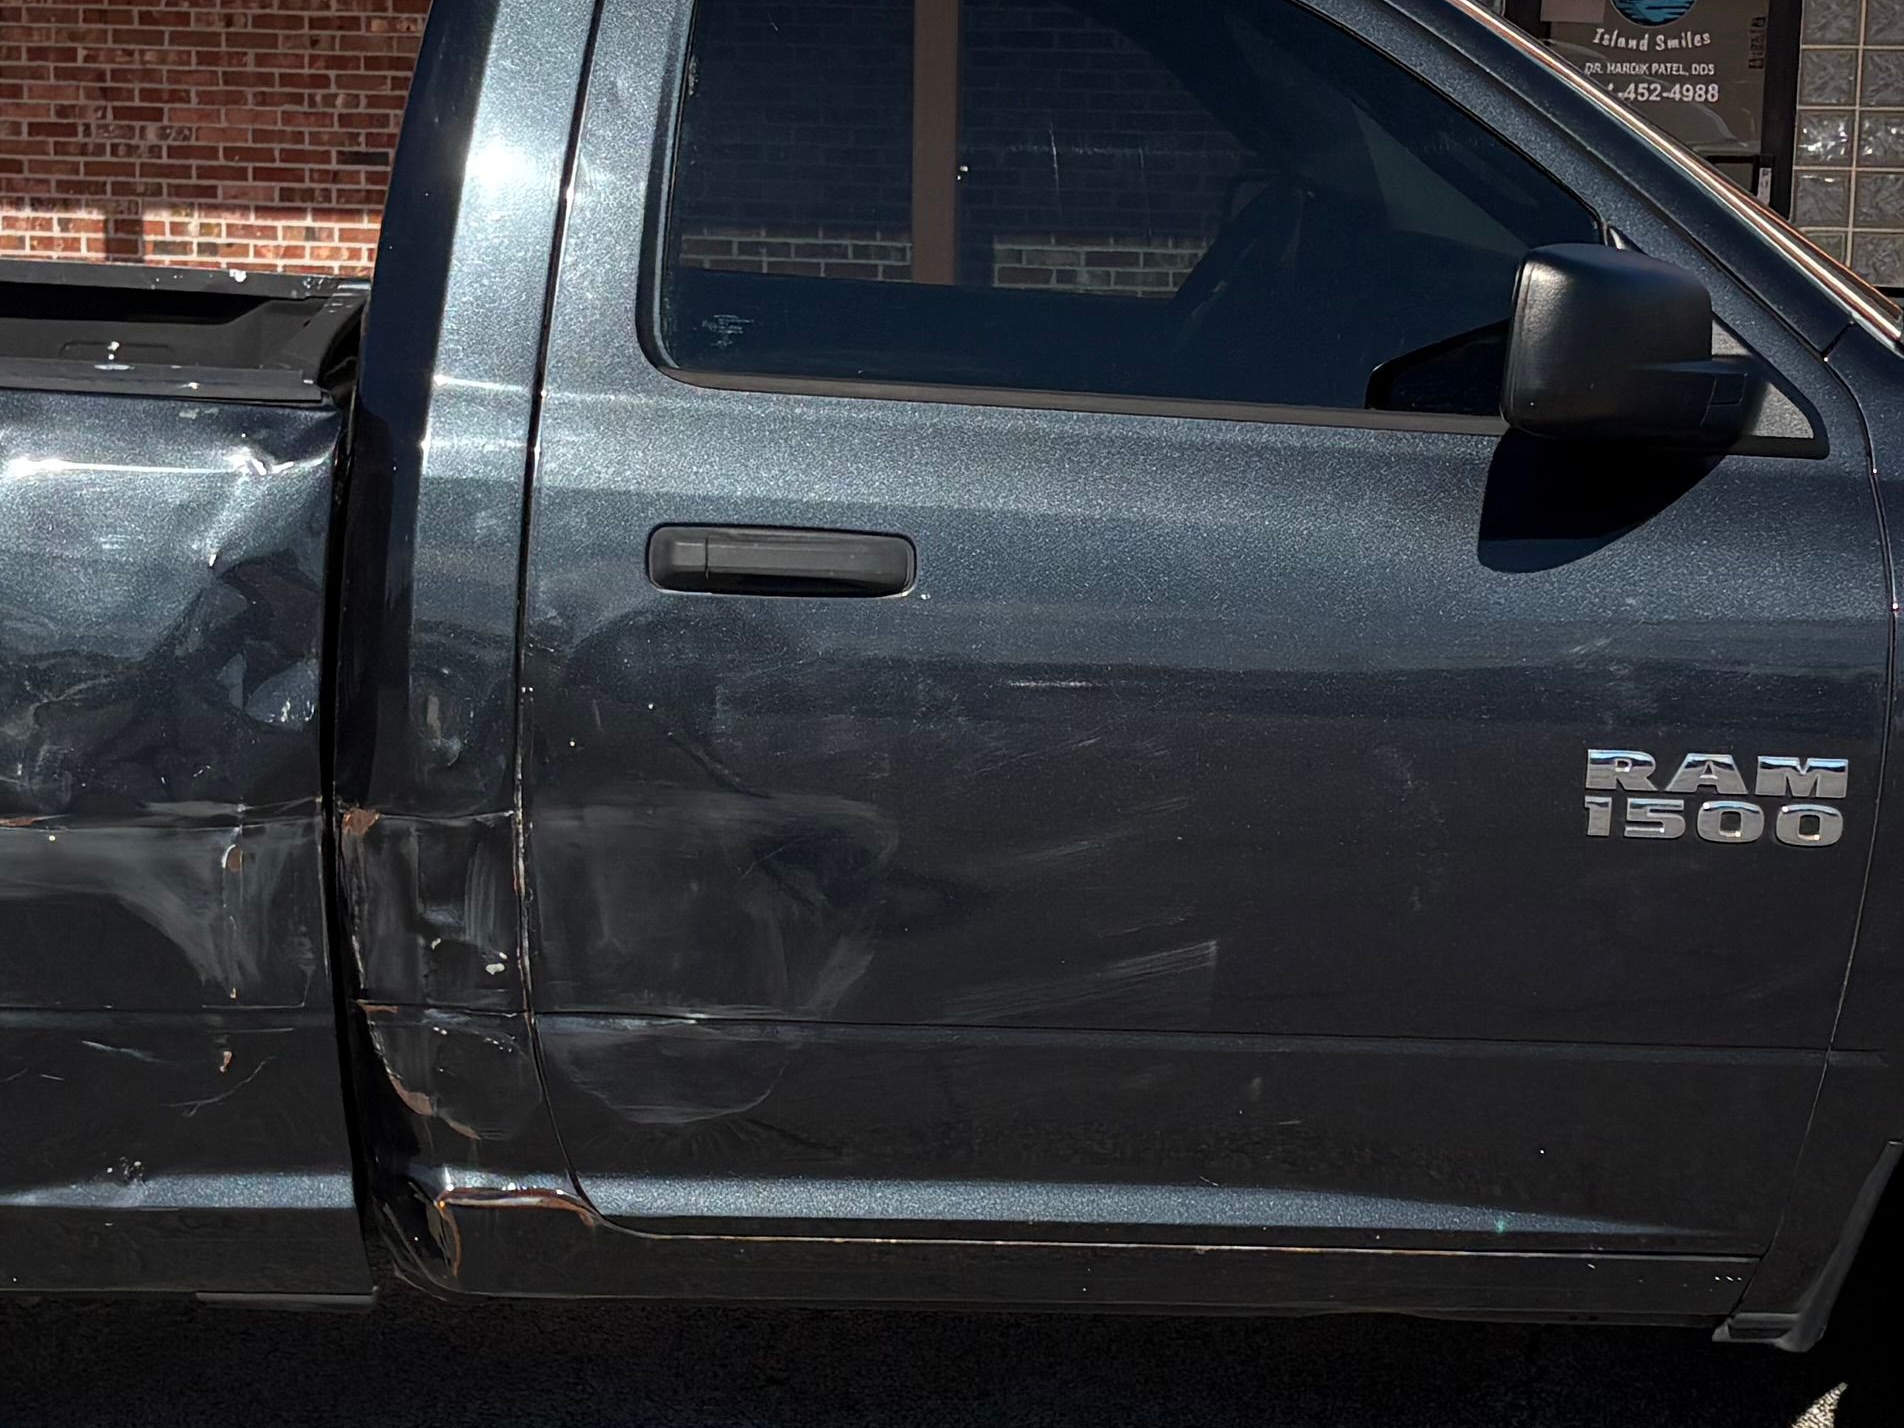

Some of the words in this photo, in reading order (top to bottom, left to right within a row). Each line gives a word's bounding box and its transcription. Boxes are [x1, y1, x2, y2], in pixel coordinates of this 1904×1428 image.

[1593, 28, 1648, 51] Island
[1655, 30, 1711, 51] Smiles
[1691, 63, 1715, 75] DDS
[1585, 749, 1848, 798] RAM
[1585, 796, 1844, 846] 1500
